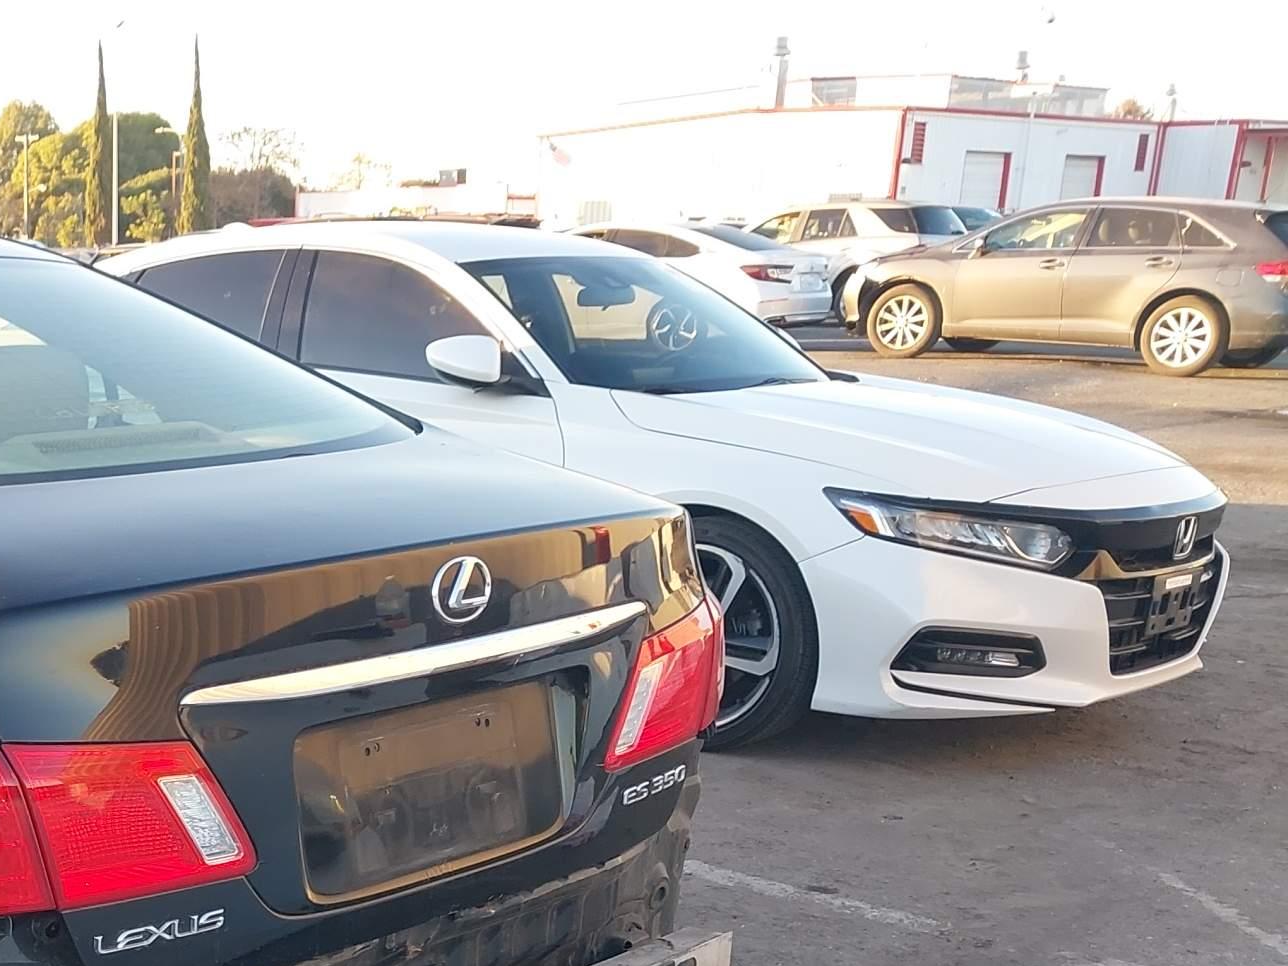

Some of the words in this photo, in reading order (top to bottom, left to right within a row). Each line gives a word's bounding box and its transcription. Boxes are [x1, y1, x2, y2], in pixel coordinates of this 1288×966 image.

[623, 781, 650, 805] ES
[651, 764, 686, 794] 350
[94, 908, 225, 955] LEXUS
